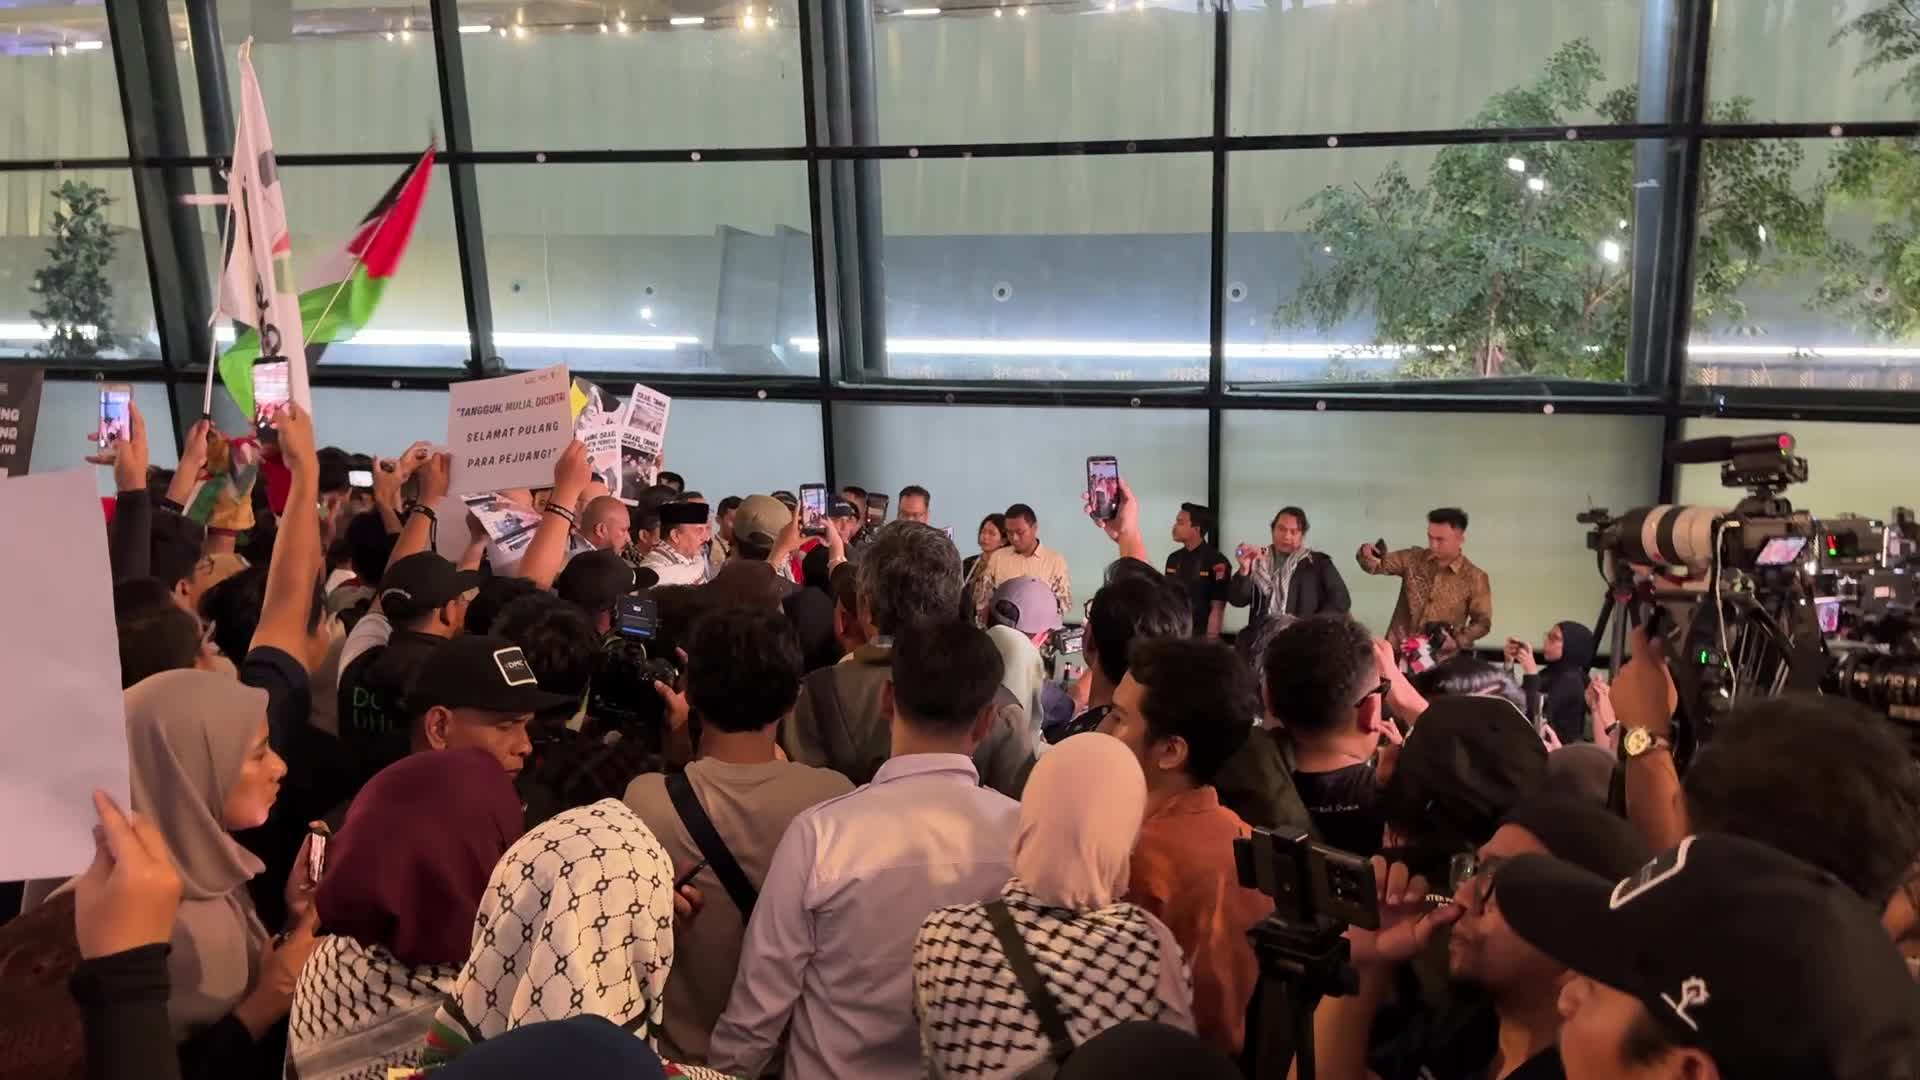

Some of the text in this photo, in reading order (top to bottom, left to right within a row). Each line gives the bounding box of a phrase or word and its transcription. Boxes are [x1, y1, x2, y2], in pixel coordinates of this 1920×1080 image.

[466, 421, 559, 443] SELAMAT PULANG
[466, 456, 495, 468] PARA
